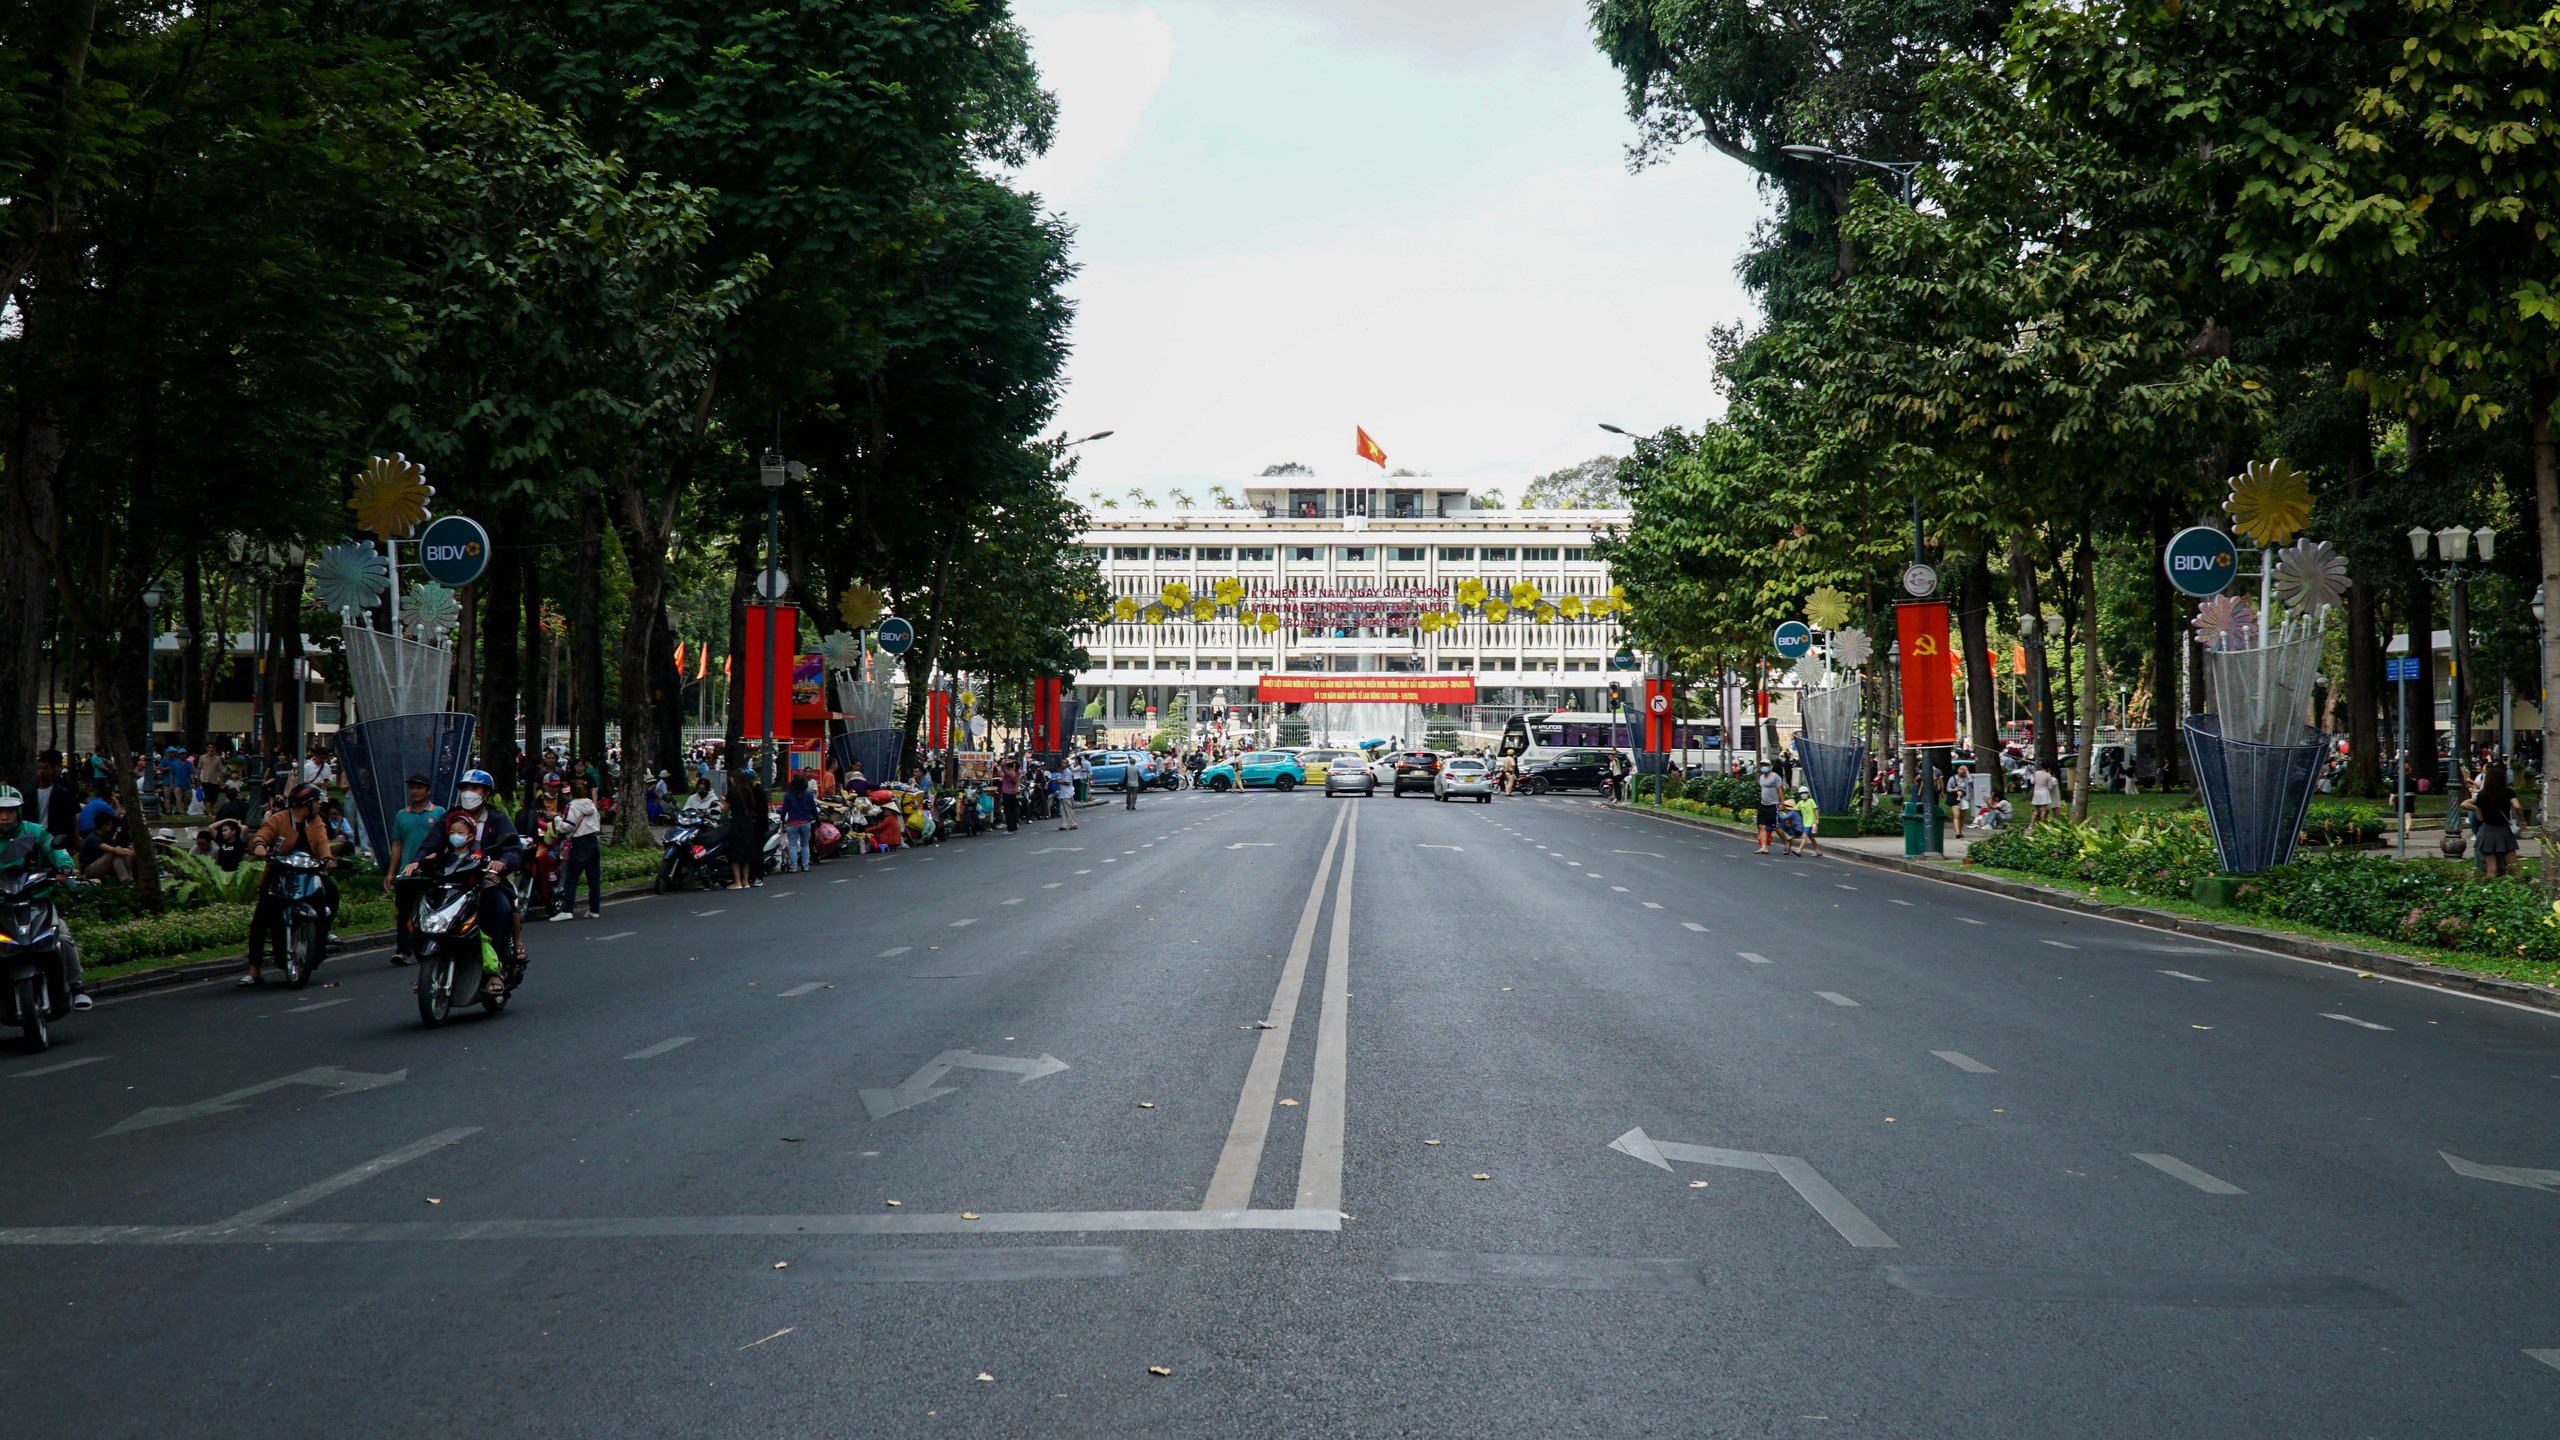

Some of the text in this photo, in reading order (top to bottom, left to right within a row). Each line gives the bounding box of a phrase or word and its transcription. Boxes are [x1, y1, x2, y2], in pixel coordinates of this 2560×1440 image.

[426, 544, 467, 561] BIDV
[2174, 555, 2217, 571] BIDV
[1301, 588, 1315, 598] 49
[1349, 585, 1381, 598] NGÀY
[1410, 585, 1449, 598] PHÓNG
[881, 632, 902, 642] BIDV
[1778, 636, 1800, 646] BIDV
